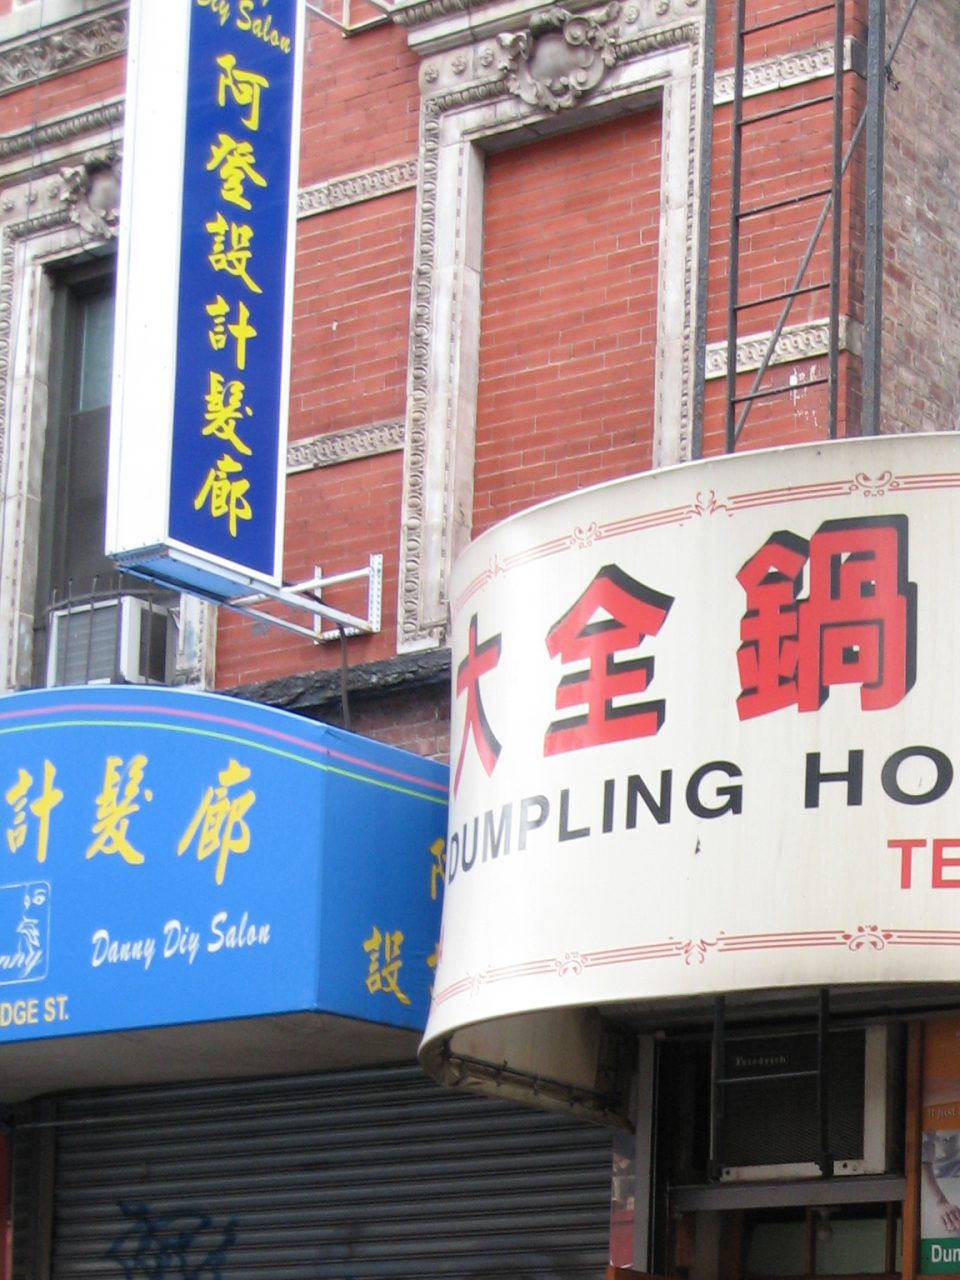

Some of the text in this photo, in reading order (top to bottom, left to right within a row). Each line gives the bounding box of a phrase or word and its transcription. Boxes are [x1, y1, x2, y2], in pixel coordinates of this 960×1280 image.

[447, 760, 744, 884] DUMPLING
[90, 911, 271, 971] Danny Diy Salon
[44, 994, 70, 1022] ST.
